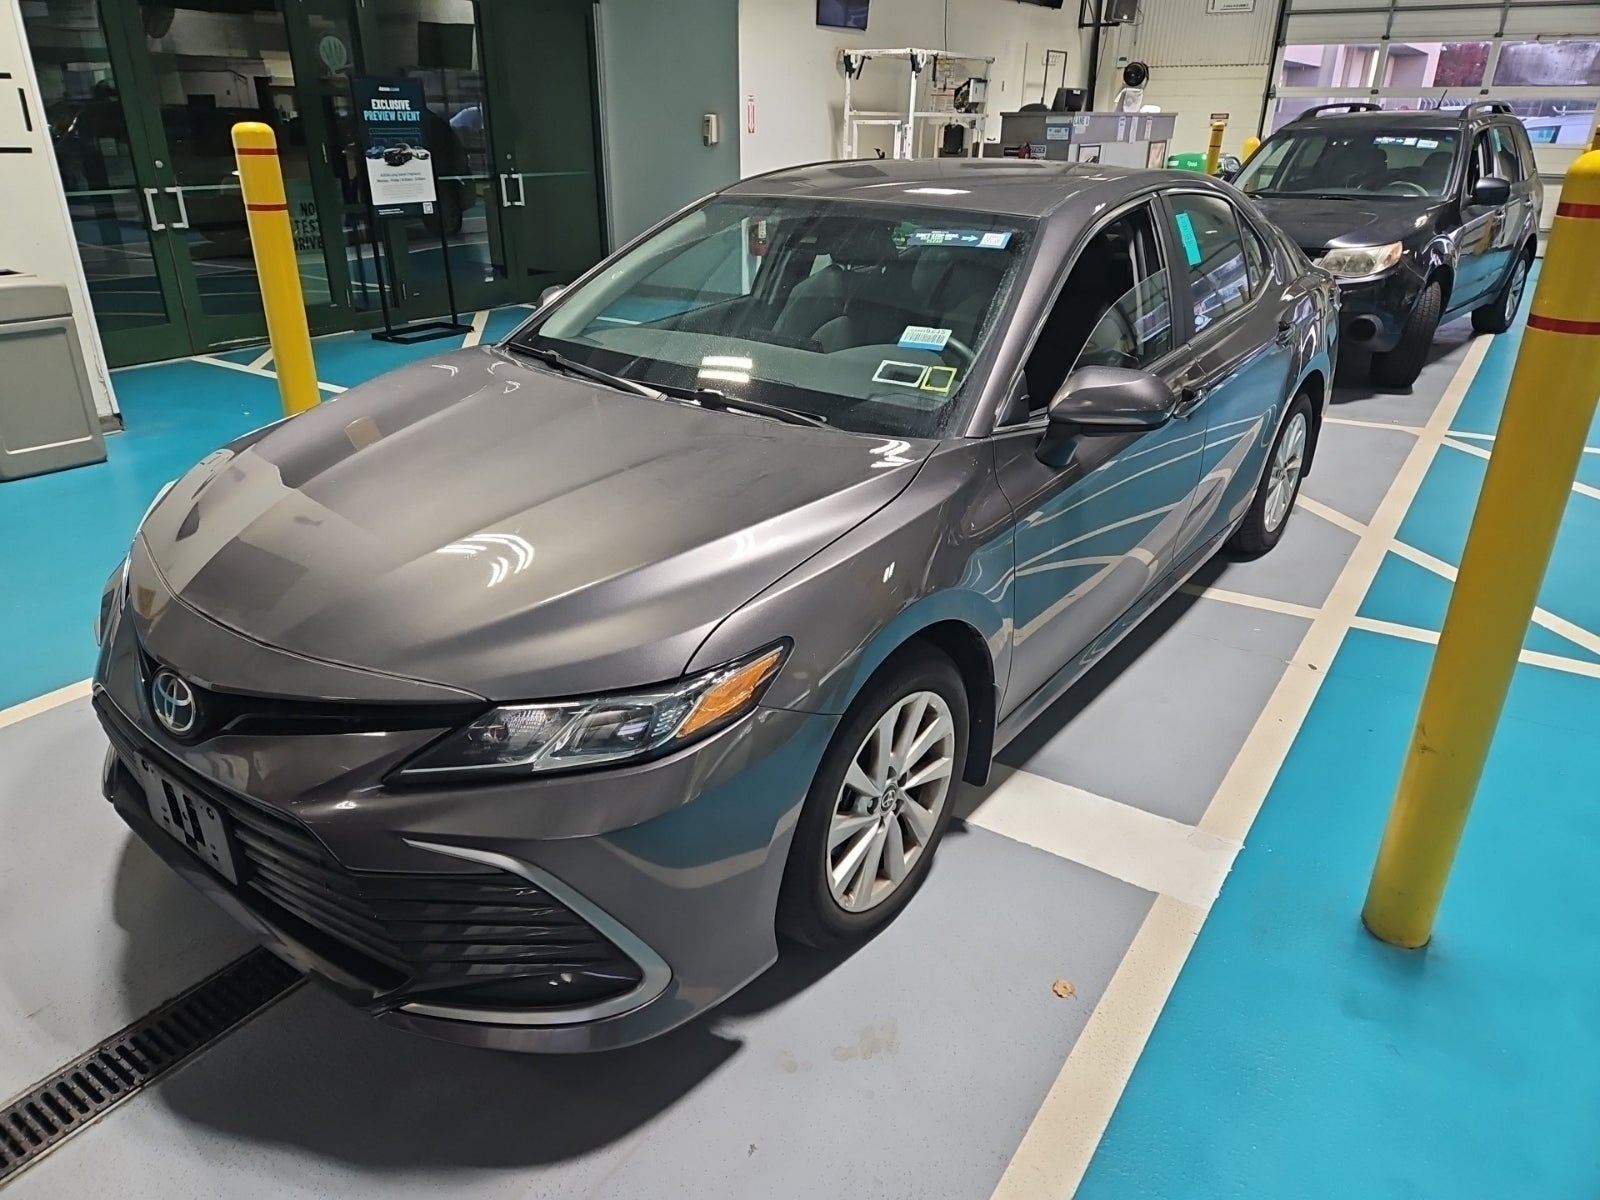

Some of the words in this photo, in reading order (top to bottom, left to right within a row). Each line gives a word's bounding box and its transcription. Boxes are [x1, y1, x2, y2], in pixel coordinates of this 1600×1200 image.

[371, 98, 411, 110] EXCLUSIVE
[363, 110, 396, 121] PREVIEW
[396, 110, 421, 121] EVENT
[300, 202, 316, 216] NO
